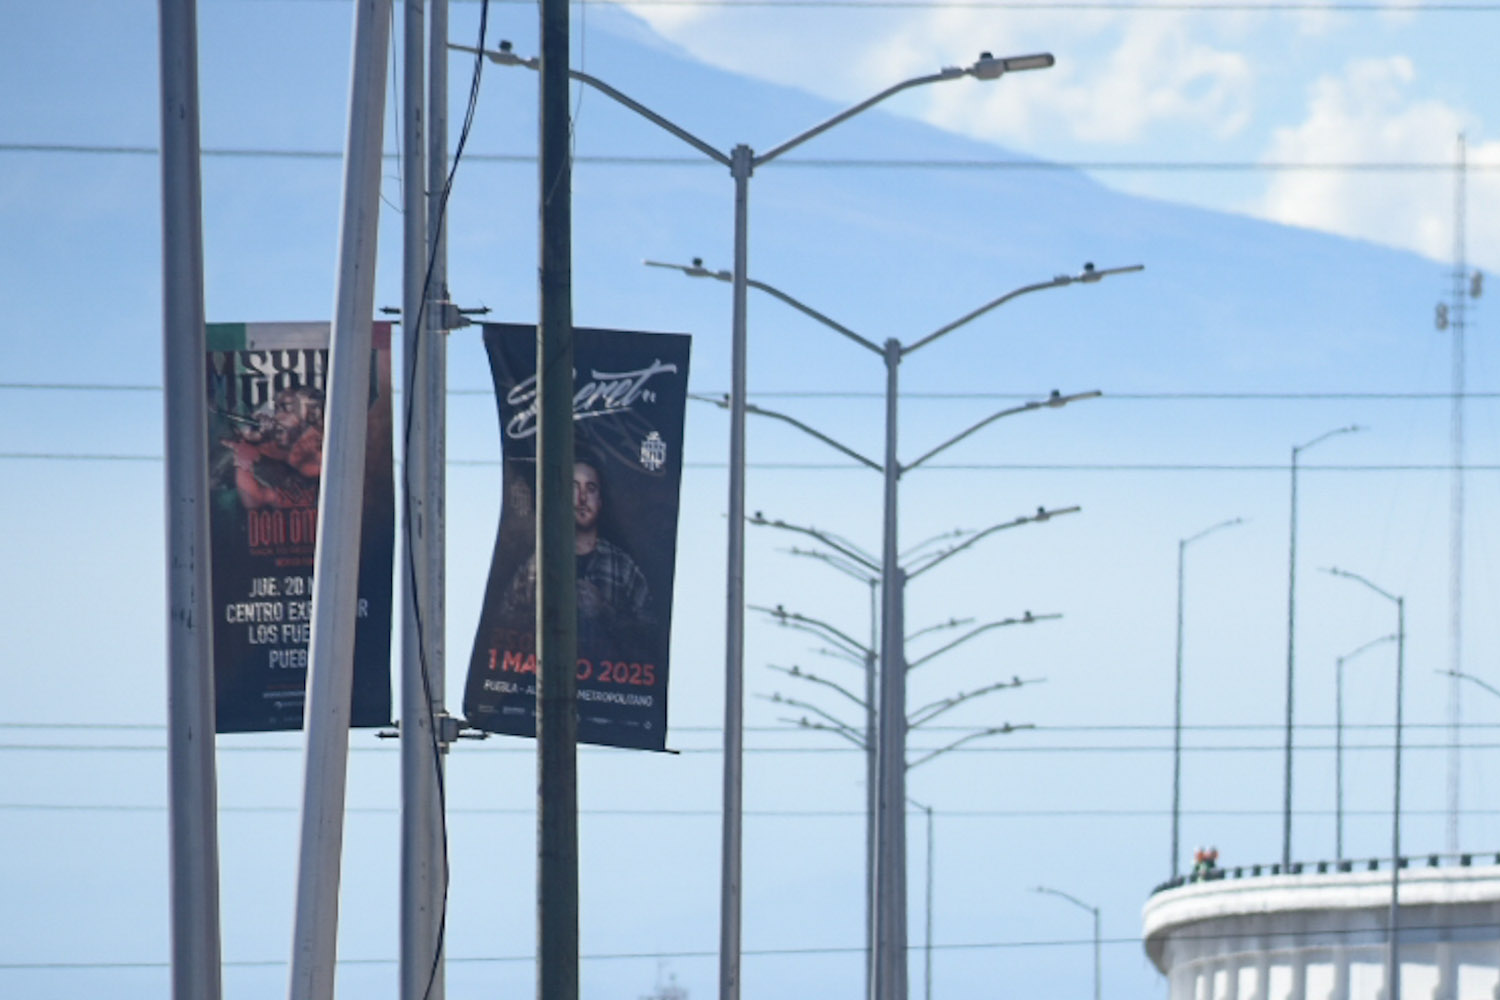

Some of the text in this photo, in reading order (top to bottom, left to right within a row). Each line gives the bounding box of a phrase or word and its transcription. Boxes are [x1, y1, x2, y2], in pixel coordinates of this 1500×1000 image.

[290, 509, 316, 544] OM
[249, 576, 280, 598] JUE.
[284, 576, 303, 597] 20
[226, 601, 284, 624] CENTRO
[248, 625, 279, 645] LOS
[269, 649, 307, 669] PUEB
[488, 648, 655, 686] 1 MAO 2025
[484, 679, 518, 694] PUEBLA
[576, 689, 653, 708] METROPOLITANO
